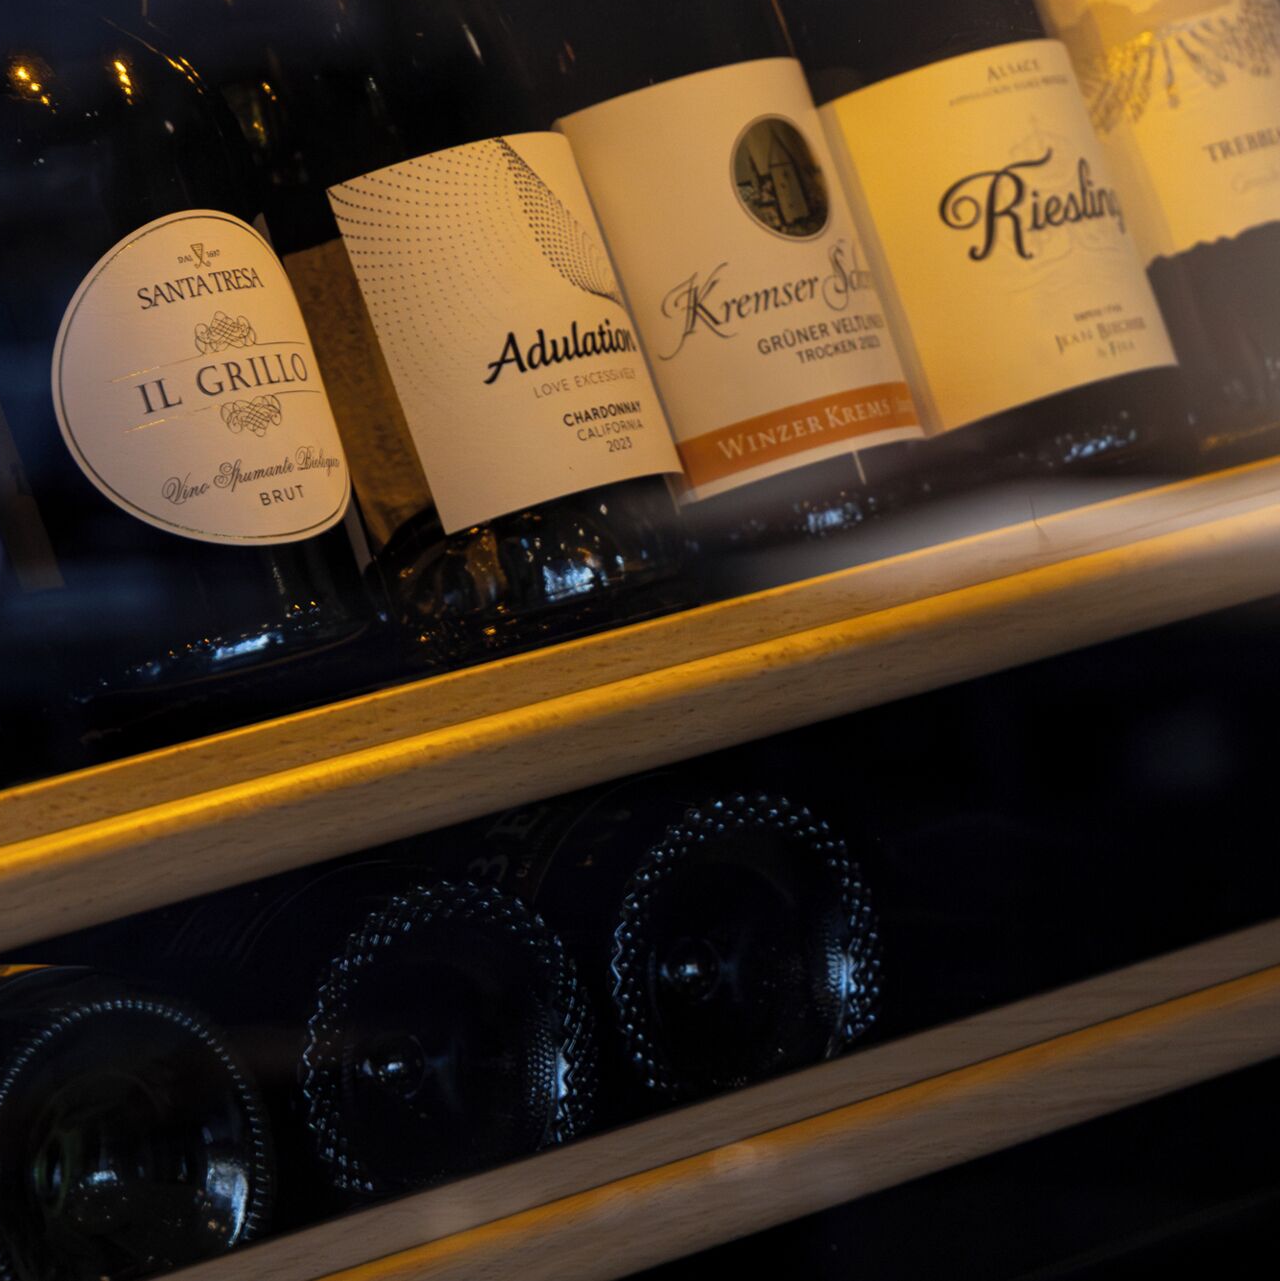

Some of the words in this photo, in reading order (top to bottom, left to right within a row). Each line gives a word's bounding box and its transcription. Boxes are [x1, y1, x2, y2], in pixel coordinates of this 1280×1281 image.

[136, 274, 214, 310] SANTA
[207, 266, 265, 293] TRESA
[657, 261, 820, 362] Kremser
[482, 317, 638, 386] Adulation
[757, 321, 831, 356] GRÜNER
[795, 339, 858, 365] TROCKEN
[135, 377, 184, 415] IL
[195, 352, 309, 397] GRILLO
[532, 377, 570, 399] LOVE
[562, 400, 642, 427] CHARDONNAY
[576, 418, 644, 442] CALIFORNIA
[606, 436, 633, 453] 2023
[161, 472, 210, 506] Vino
[212, 457, 295, 493] Spumante
[259, 484, 305, 507] BRUT
